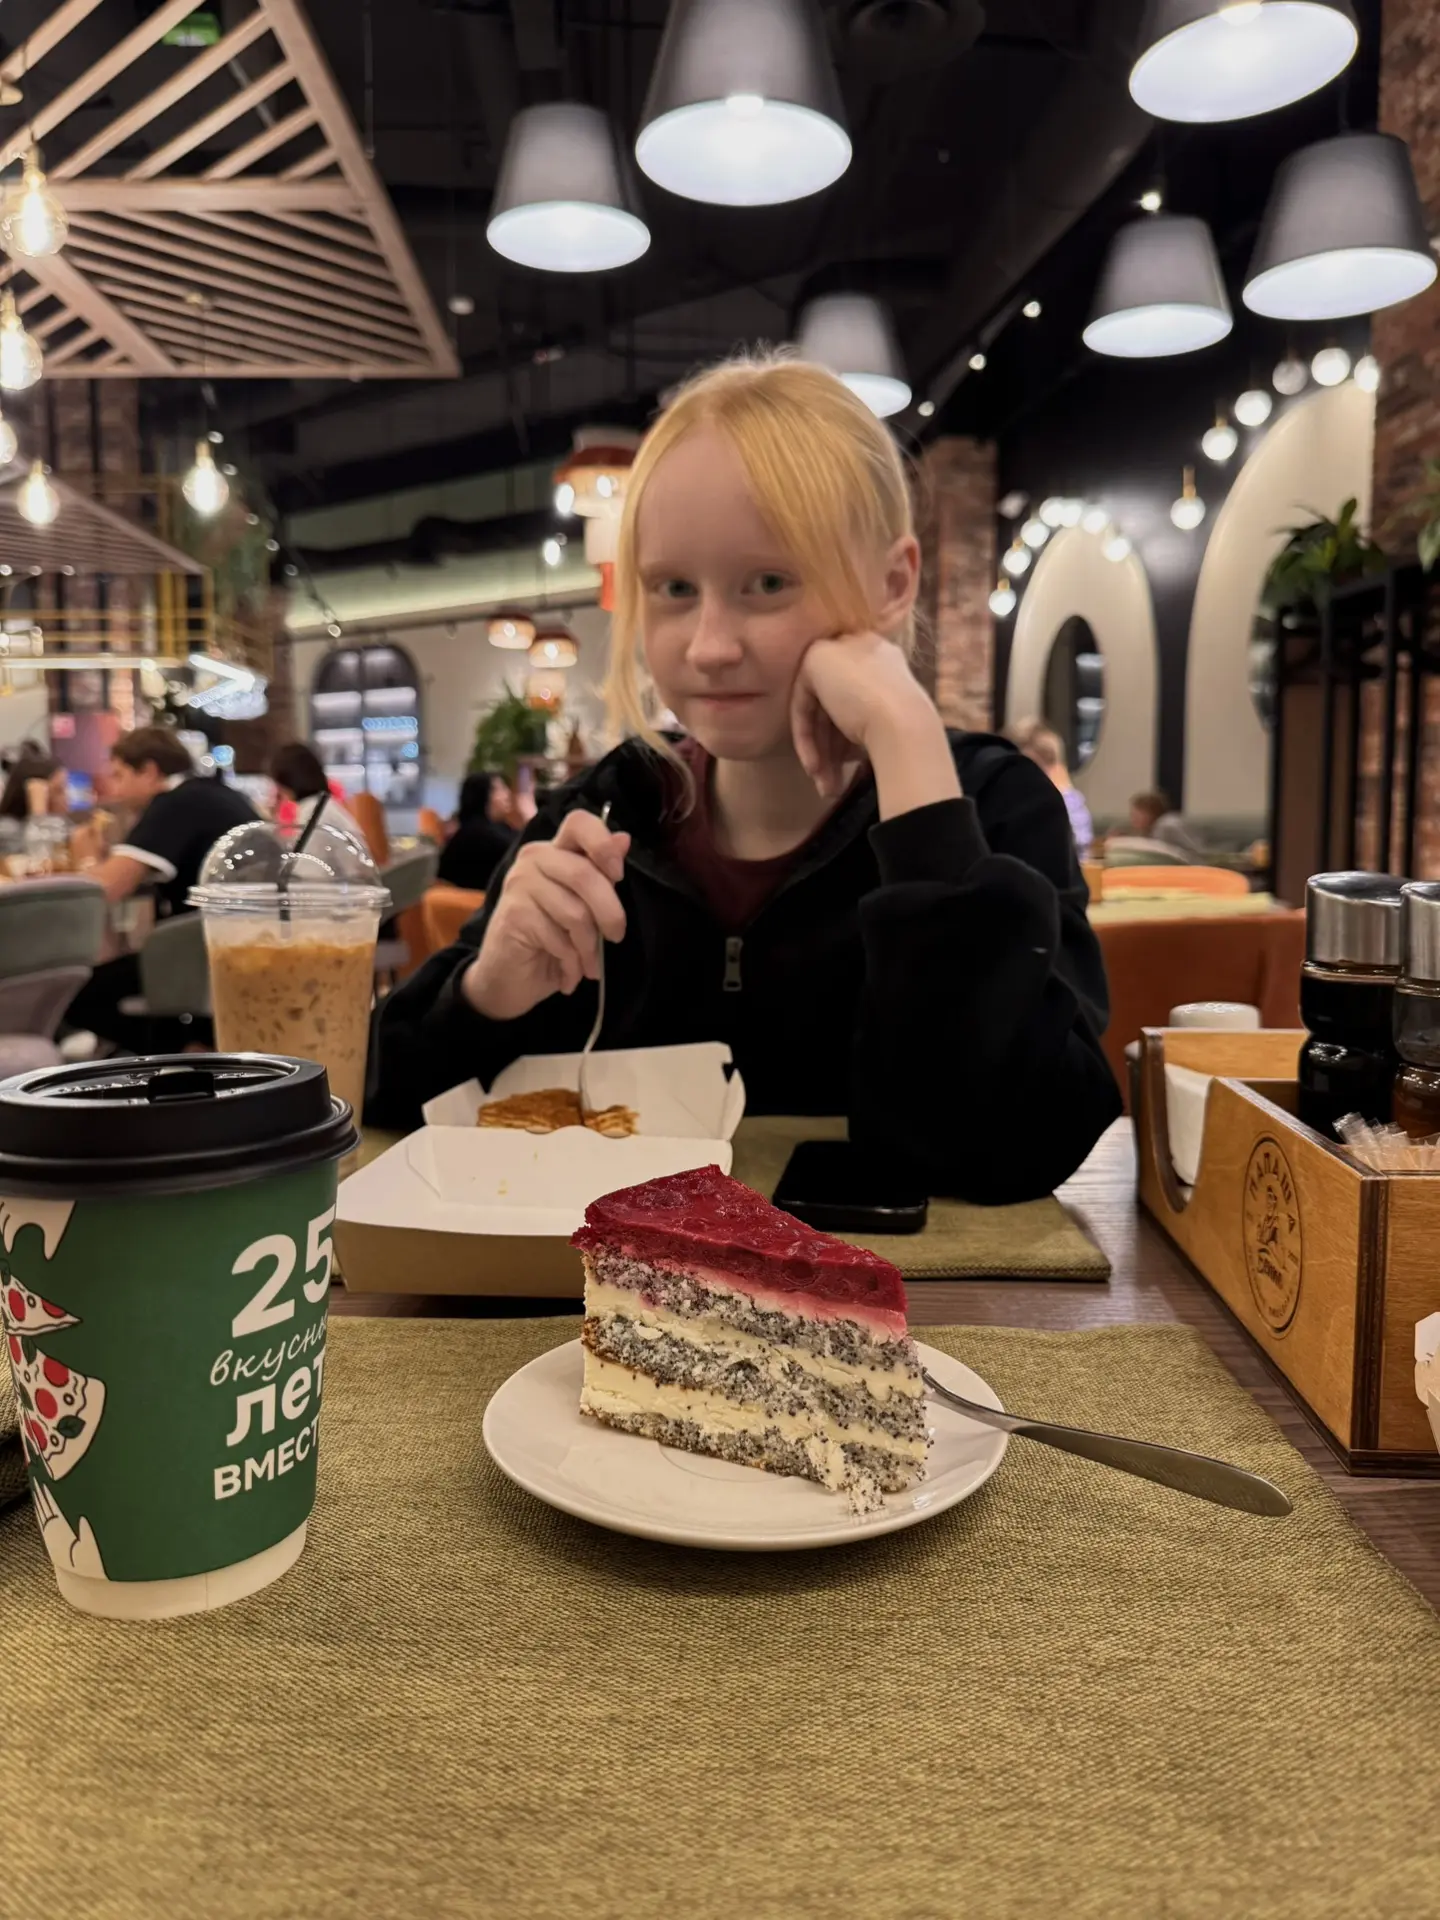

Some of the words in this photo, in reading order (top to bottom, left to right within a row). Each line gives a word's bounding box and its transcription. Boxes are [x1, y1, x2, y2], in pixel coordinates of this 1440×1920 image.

[1249, 1152, 1296, 1234] ПАПАША
[231, 1204, 335, 1338] 25
[226, 1344, 326, 1447] лет
